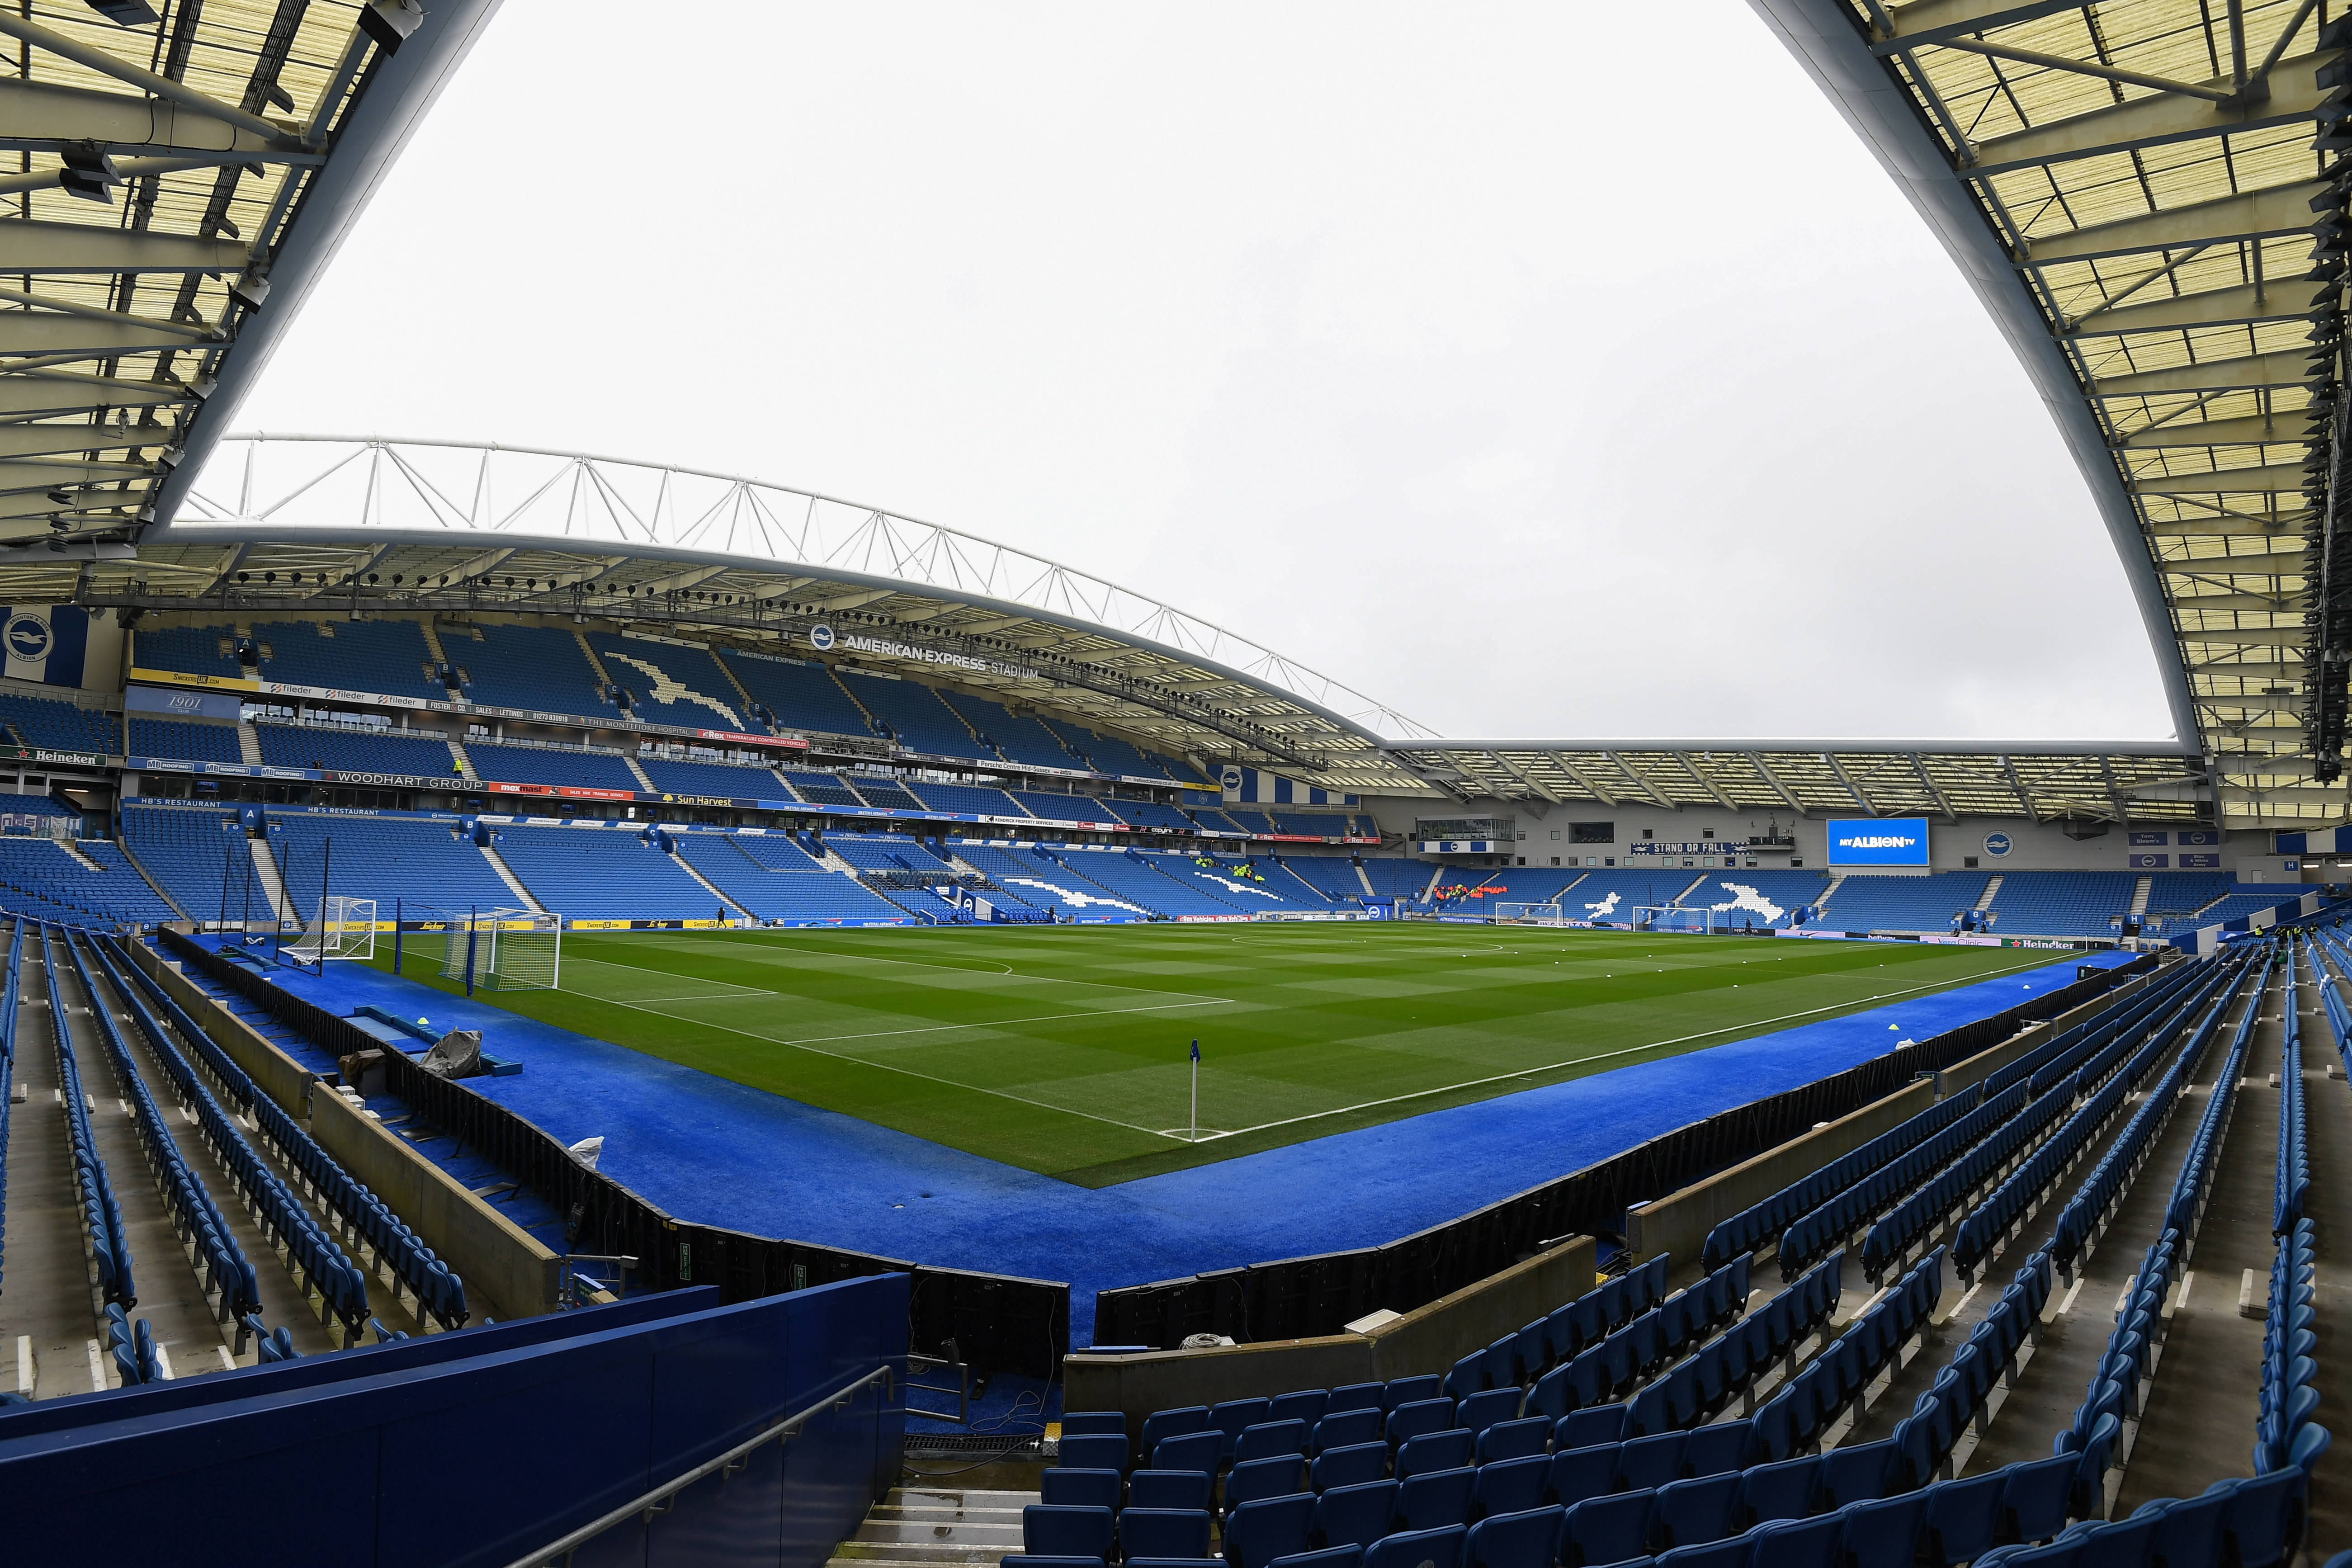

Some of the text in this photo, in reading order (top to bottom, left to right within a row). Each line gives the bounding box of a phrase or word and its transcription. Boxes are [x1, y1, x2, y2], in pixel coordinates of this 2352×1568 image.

[9, 615, 33, 624] BRIGHTON
[40, 621, 50, 632] HOVE
[737, 651, 806, 666] AMERICAN EXPRESS
[845, 635, 1038, 680] AMERICAN EXPRESS STADIUM
[283, 685, 312, 694] fileder
[337, 690, 365, 700] fileder
[168, 696, 201, 709] 1901
[389, 696, 416, 705] fileder
[430, 702, 451, 710] FOSTER
[476, 706, 492, 714] SALES
[499, 709, 523, 718] LETTINGS
[549, 713, 568, 723] 830919
[609, 721, 656, 732] MONTEFIORE
[658, 727, 690, 735] HOSPITAL
[708, 731, 724, 739] Rex
[36, 750, 96, 765] Heineken
[206, 764, 219, 772] MB
[1021, 765, 1050, 773] Mid-Sussex
[338, 772, 483, 789] WOODHART GROUP
[165, 799, 221, 808] RESTAURANT
[677, 796, 732, 806] Sun Harvest
[246, 810, 254, 818] A
[329, 808, 379, 816] RESTAURANT
[1654, 843, 1726, 852] STAND OR FALL
